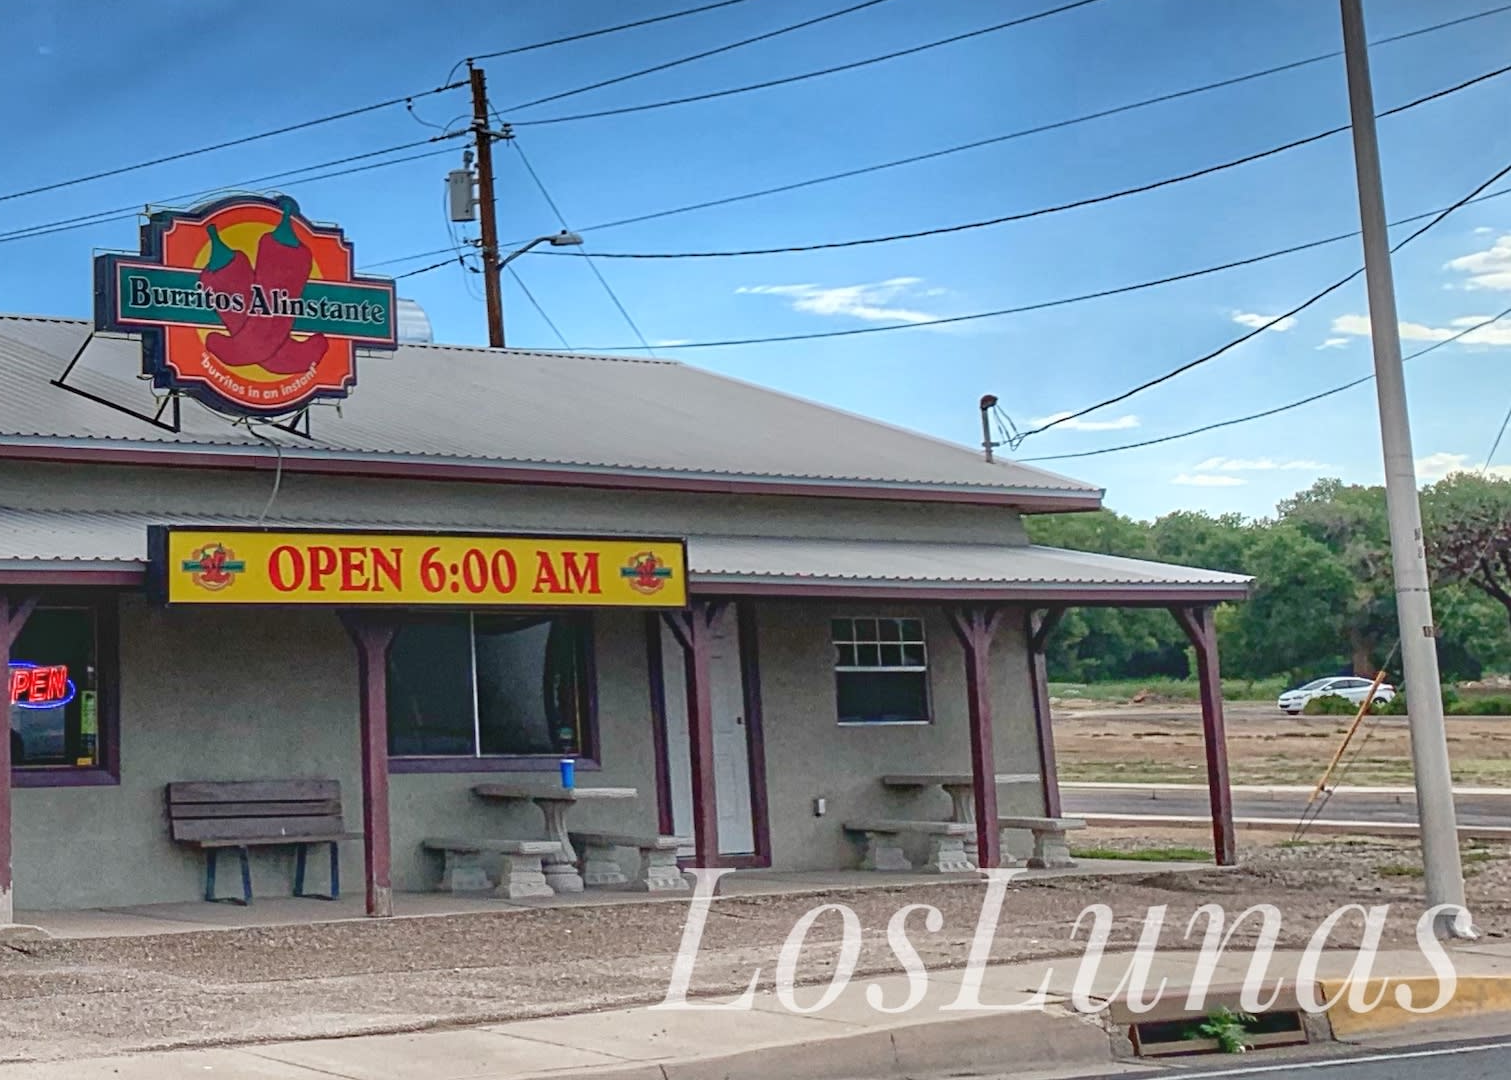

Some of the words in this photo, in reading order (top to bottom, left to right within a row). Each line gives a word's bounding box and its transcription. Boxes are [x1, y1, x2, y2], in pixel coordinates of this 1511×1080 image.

[128, 276, 244, 311] Burritos
[248, 284, 385, 323] Alinstante
[248, 386, 261, 399] in
[263, 390, 279, 399] an
[267, 544, 404, 594] OPEN
[419, 546, 518, 595] 6:00
[532, 551, 602, 594] AM
[8, 665, 68, 704] PEN
